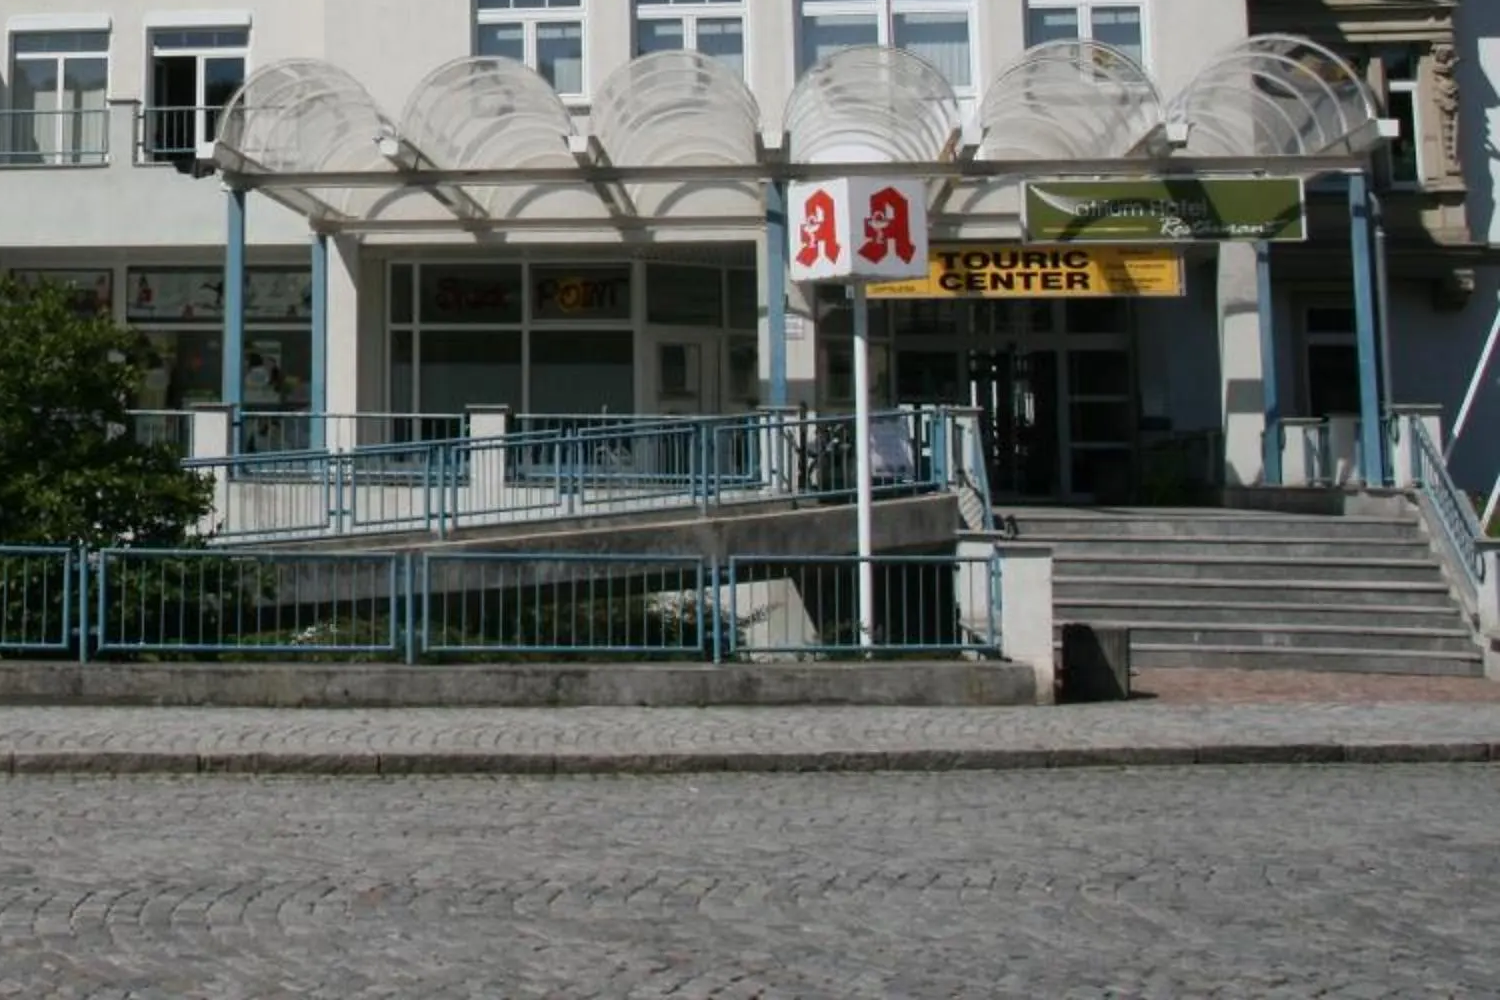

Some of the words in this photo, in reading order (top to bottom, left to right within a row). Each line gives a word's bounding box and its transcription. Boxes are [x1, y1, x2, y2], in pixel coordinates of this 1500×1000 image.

[1150, 198, 1208, 217] Hotel
[937, 251, 1091, 270] TOURIC
[939, 271, 1091, 291] CENTER
